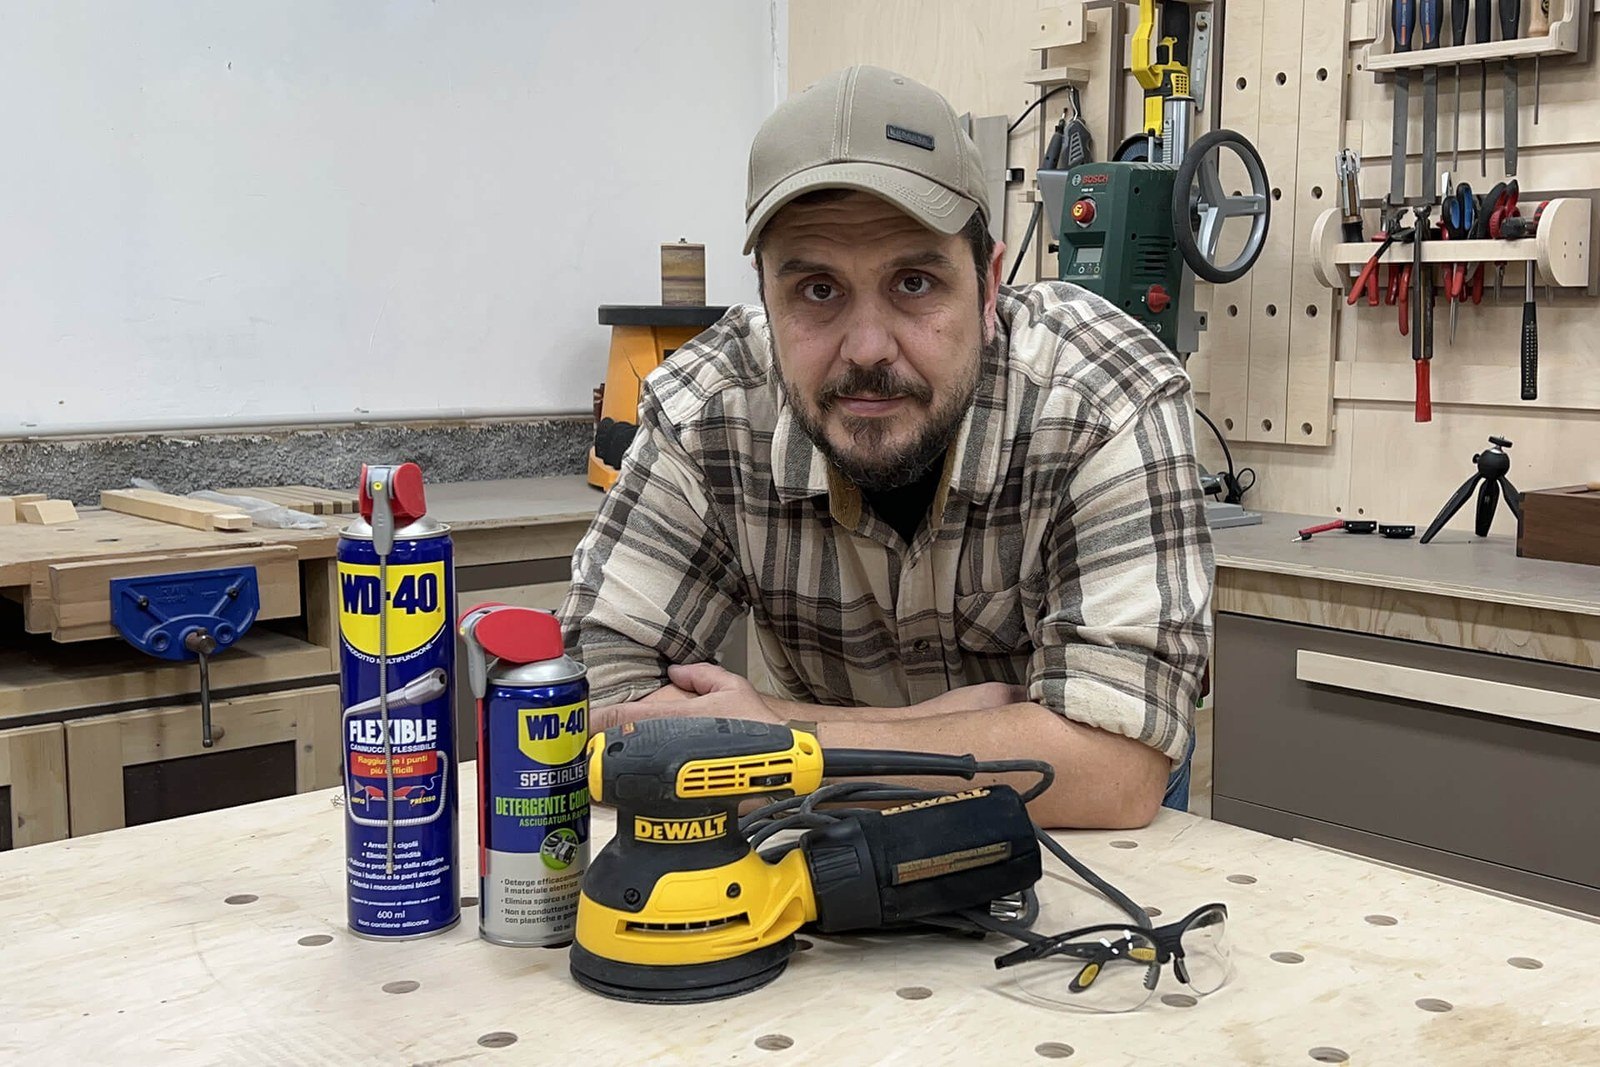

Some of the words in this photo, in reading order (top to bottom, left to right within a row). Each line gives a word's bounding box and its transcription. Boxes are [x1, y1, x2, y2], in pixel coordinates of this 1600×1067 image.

[1083, 174, 1108, 184] BOSCH
[340, 572, 438, 615] WD-40
[525, 707, 585, 741] WD-40
[349, 719, 437, 744] FLEXIBLE
[350, 743, 388, 753] CANNUCCI
[392, 742, 436, 753] FLESSIBILE
[406, 755, 428, 765] punti
[384, 766, 413, 775] dfficili
[495, 794, 567, 816] DETERGENTE
[519, 807, 571, 827] ASCIUGATURA
[504, 878, 536, 887] Deterge
[510, 887, 548, 895] materiale
[533, 895, 560, 905] sporco
[376, 910, 393, 919] 600
[394, 910, 405, 919] ml
[519, 914, 556, 925] plastiche
[402, 919, 429, 928] silicone
